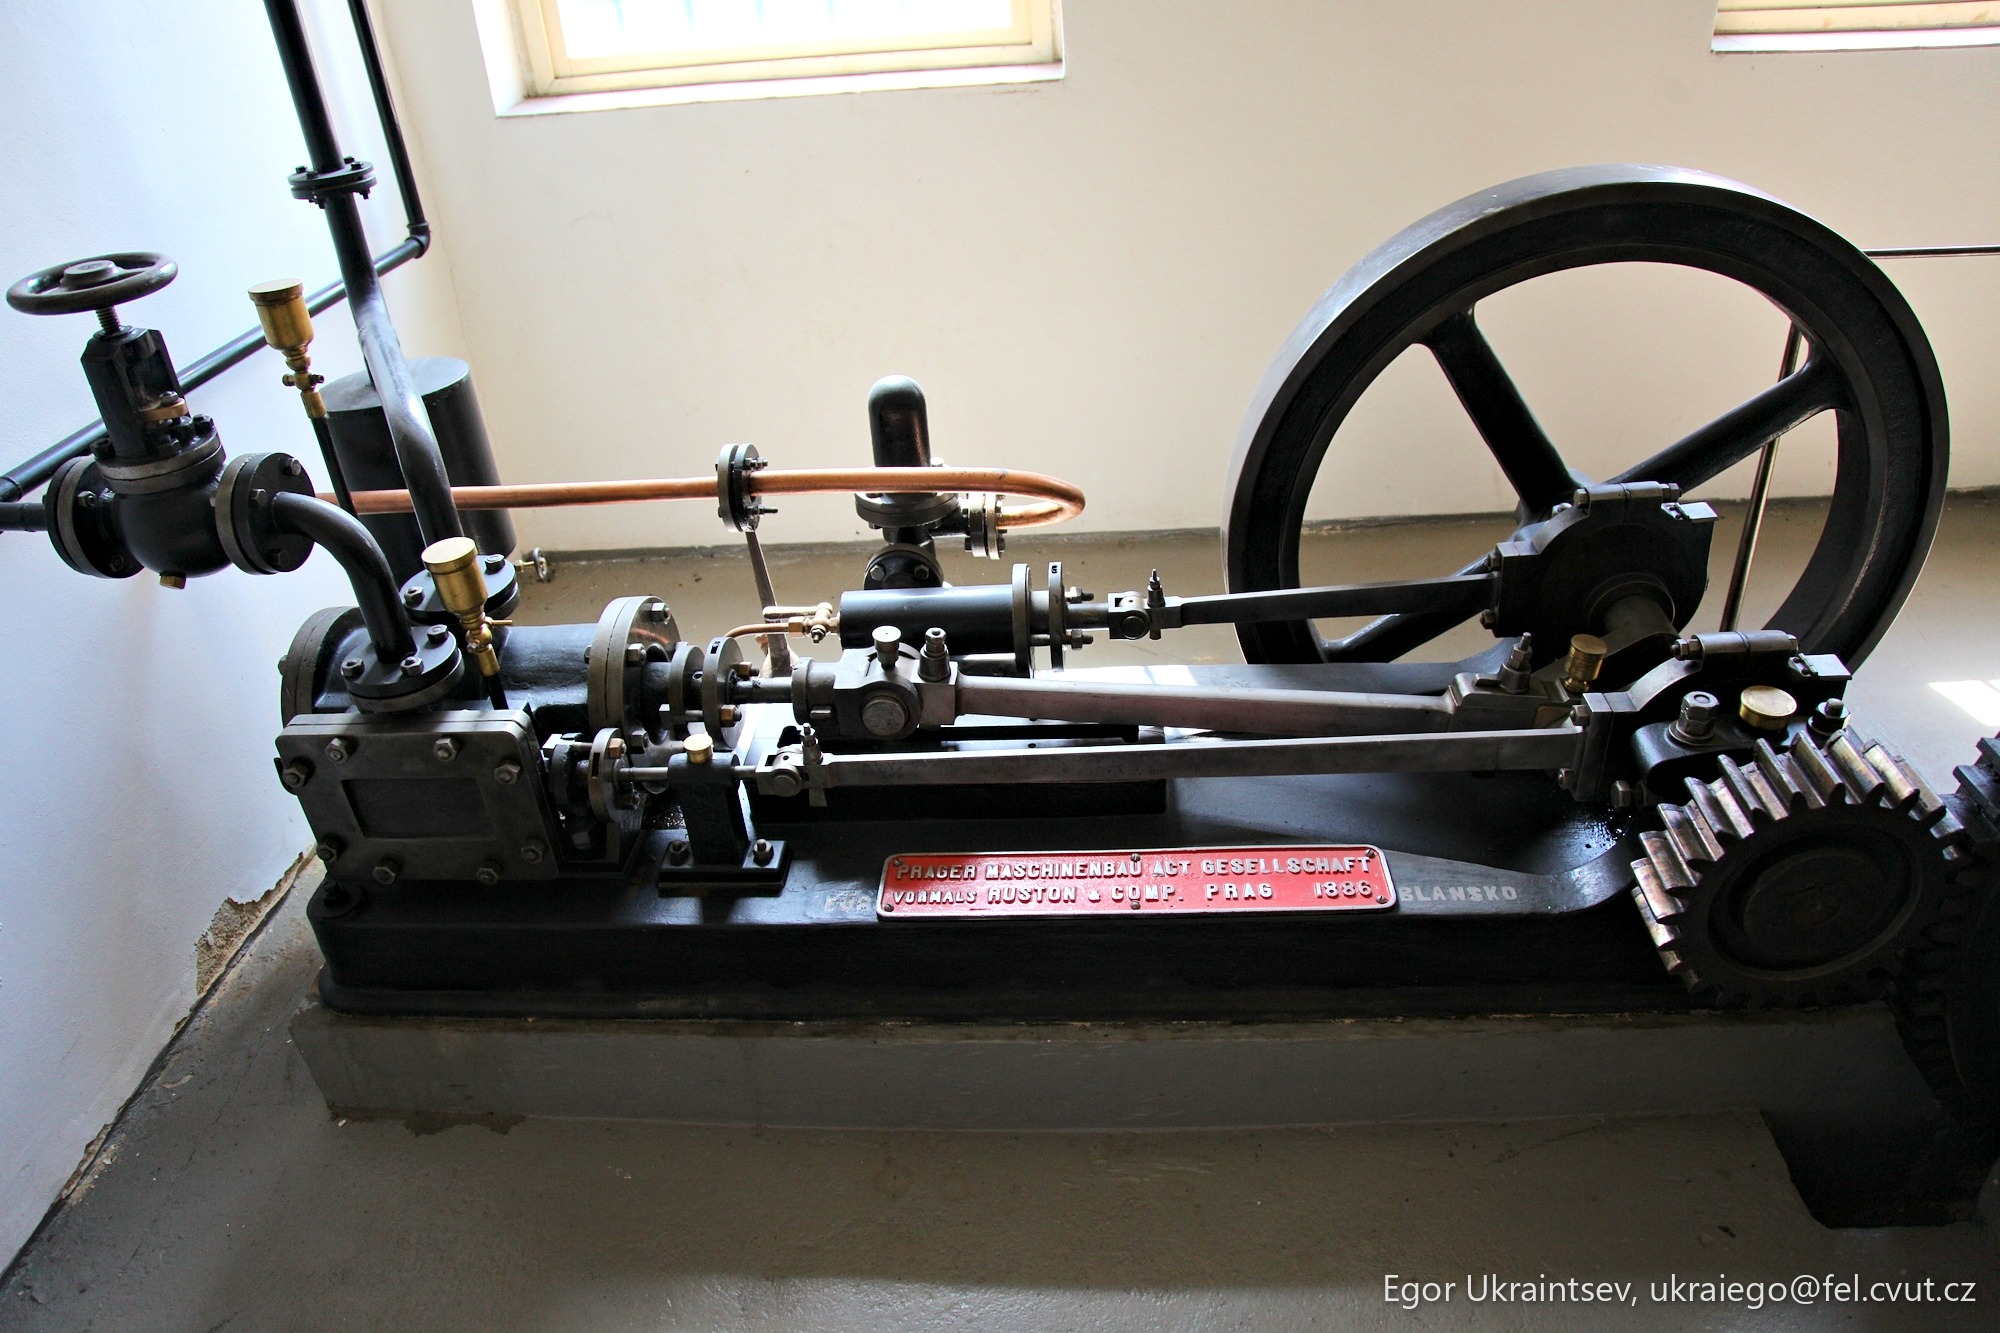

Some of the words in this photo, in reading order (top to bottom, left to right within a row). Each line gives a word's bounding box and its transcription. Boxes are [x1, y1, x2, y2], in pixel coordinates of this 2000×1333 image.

[897, 864, 976, 880] PRAGER
[986, 860, 1142, 880] MASCHINENBAU
[1153, 860, 1190, 876] ACT
[1202, 857, 1371, 875] GESELLSCHAFT
[893, 891, 977, 904] VORMALS
[988, 887, 1076, 904] RUSTON
[1088, 890, 1101, 901] &
[1111, 884, 1184, 901] COMP.
[1206, 883, 1273, 900] PRAG
[1314, 881, 1373, 899] 1886
[1398, 886, 1518, 902] BLANSKO
